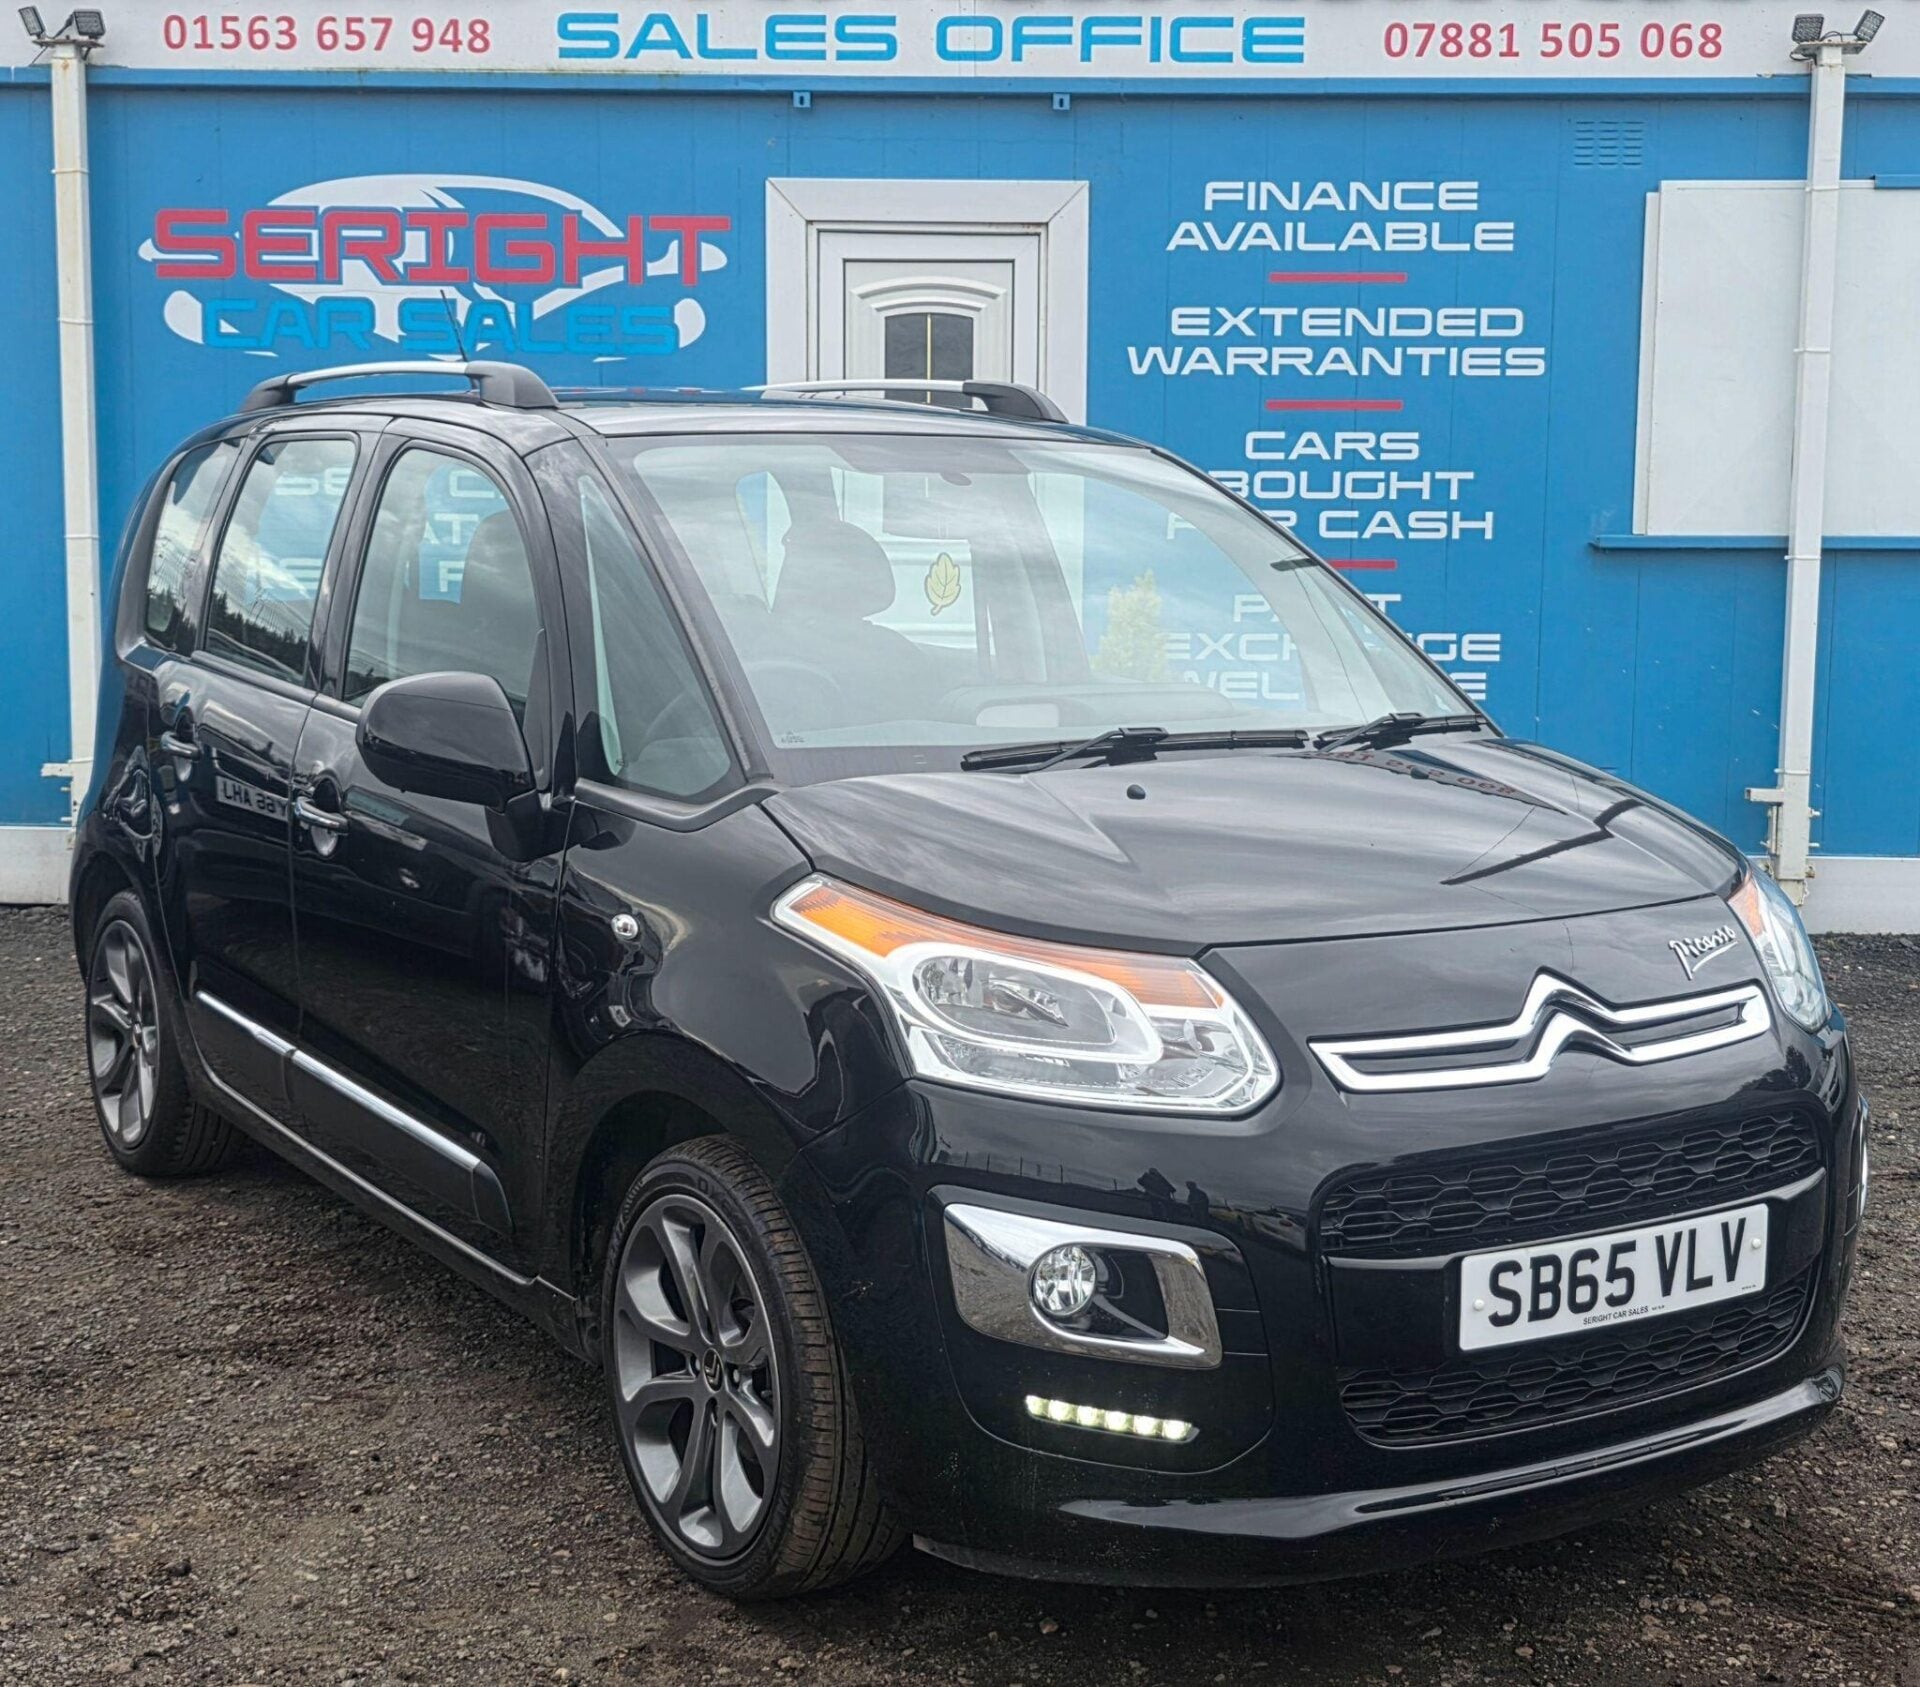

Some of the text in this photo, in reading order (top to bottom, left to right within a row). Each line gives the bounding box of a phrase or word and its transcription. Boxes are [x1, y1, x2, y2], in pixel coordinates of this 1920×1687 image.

[164, 15, 491, 53] 01563 657 948
[556, 12, 1306, 64] SALES OFFICE
[1384, 23, 1723, 59] 07881 505 068
[1204, 181, 1479, 211] FINANCE
[154, 208, 731, 286] SERIGHT
[1166, 222, 1515, 251] AVAILABLE
[204, 297, 679, 355] CAR SALES
[1171, 307, 1524, 336] EXTENDED
[1127, 346, 1546, 376] WARRANTIES
[1245, 431, 1419, 460] CARS
[1318, 510, 1494, 540] CASH
[1232, 593, 1402, 623] PT
[1487, 1216, 1747, 1328] SB65 VLV
[1583, 1312, 1612, 1326] SERIGHT
[1613, 1309, 1627, 1321] CAR
[1628, 1305, 1649, 1318] SALES
